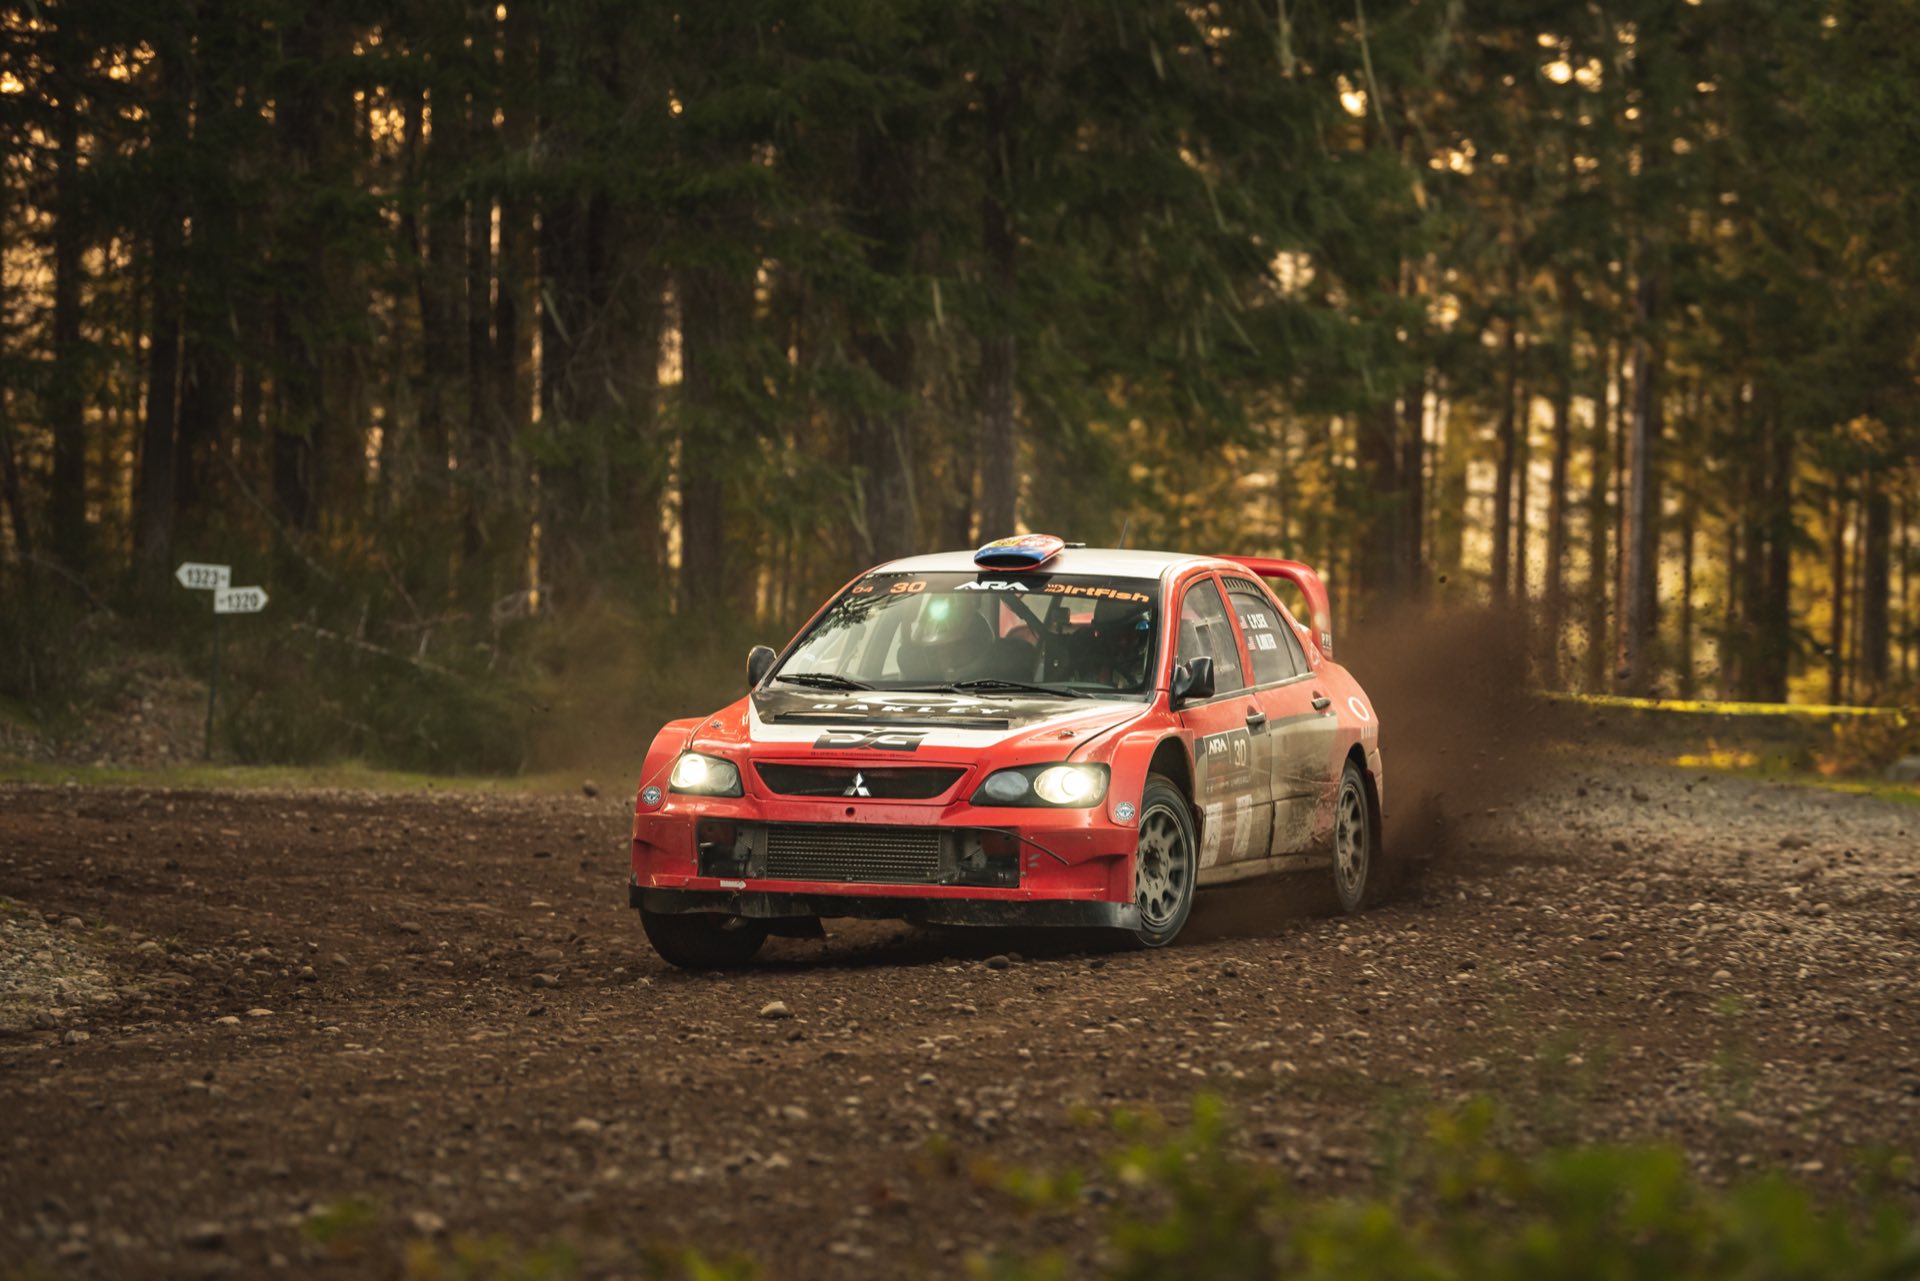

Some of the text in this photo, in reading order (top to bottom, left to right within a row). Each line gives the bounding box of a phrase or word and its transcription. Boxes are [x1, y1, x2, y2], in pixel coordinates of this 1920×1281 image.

[187, 569, 218, 585] 1323
[890, 581, 928, 593] 30
[954, 580, 1030, 591] ARA
[1048, 583, 1149, 602] DirtFish
[228, 593, 258, 609] 1320
[812, 703, 1008, 714] OAKLEY
[1208, 738, 1228, 755] ARA
[1234, 738, 1246, 766] 30
